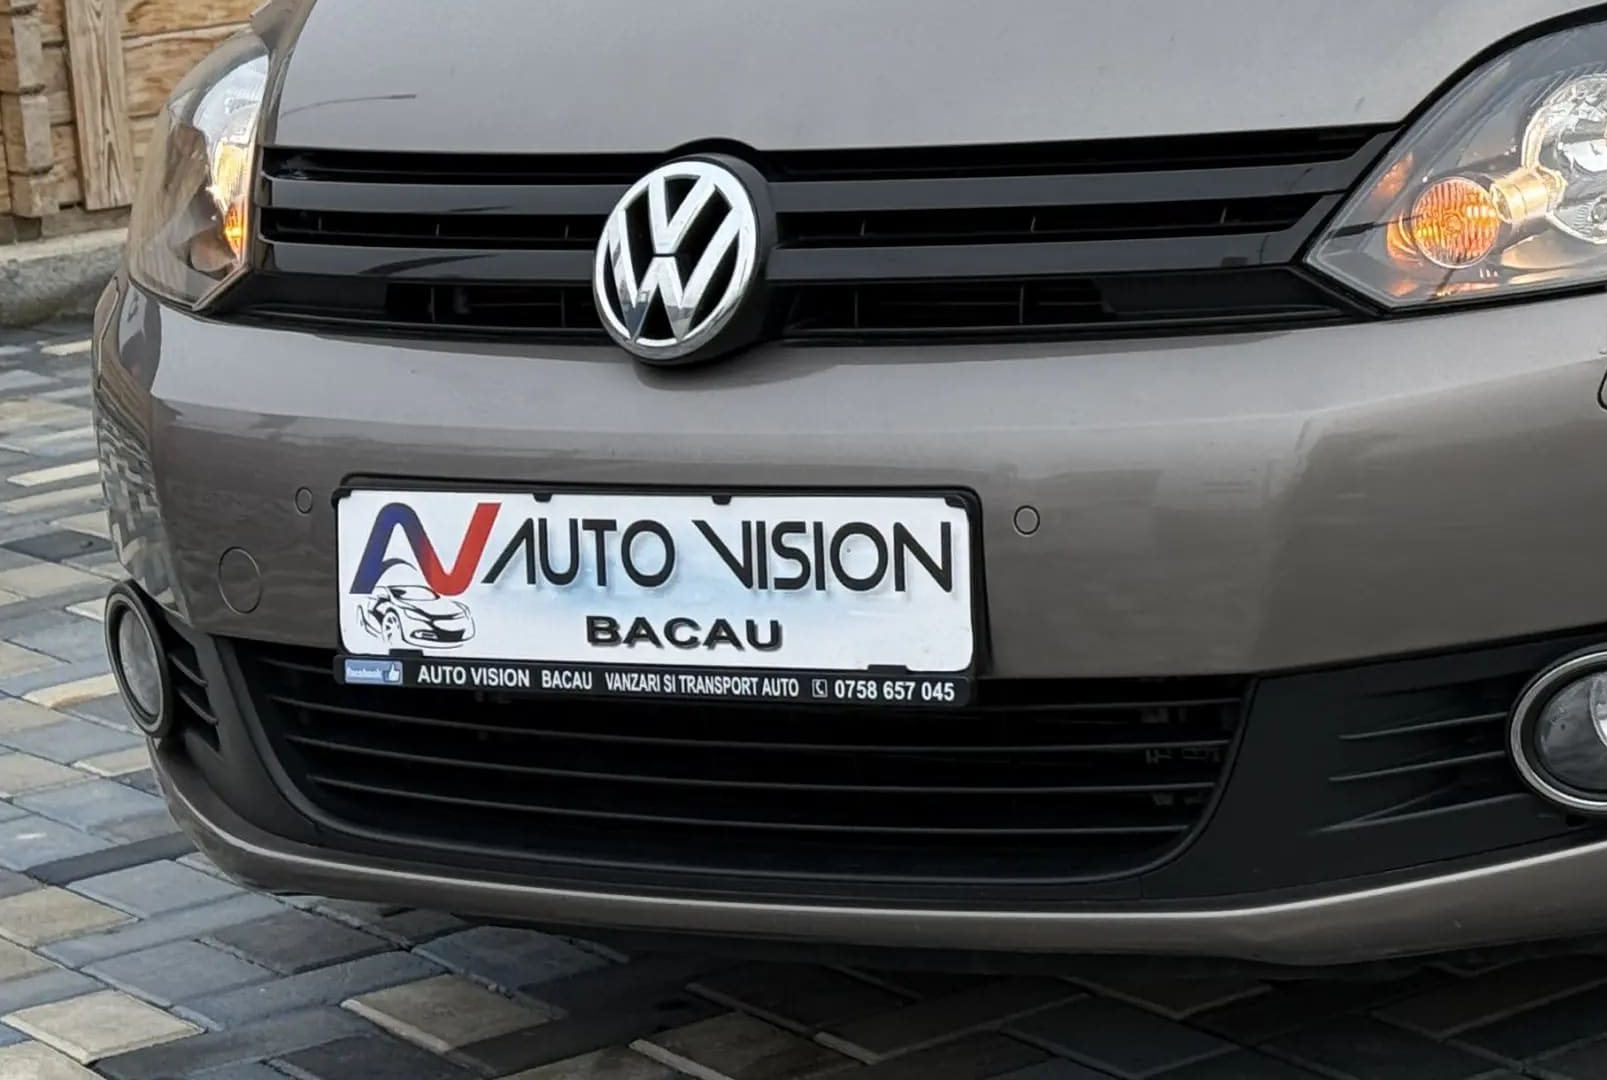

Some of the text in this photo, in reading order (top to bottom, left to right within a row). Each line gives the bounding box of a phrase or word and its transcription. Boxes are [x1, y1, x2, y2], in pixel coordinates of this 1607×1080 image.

[481, 518, 952, 592] AUTO VISION
[586, 615, 783, 651] BACAU
[418, 665, 955, 701] AUTO VISION BACAU VANZARI SI TRANSPORT AUTO 0758 657 045
